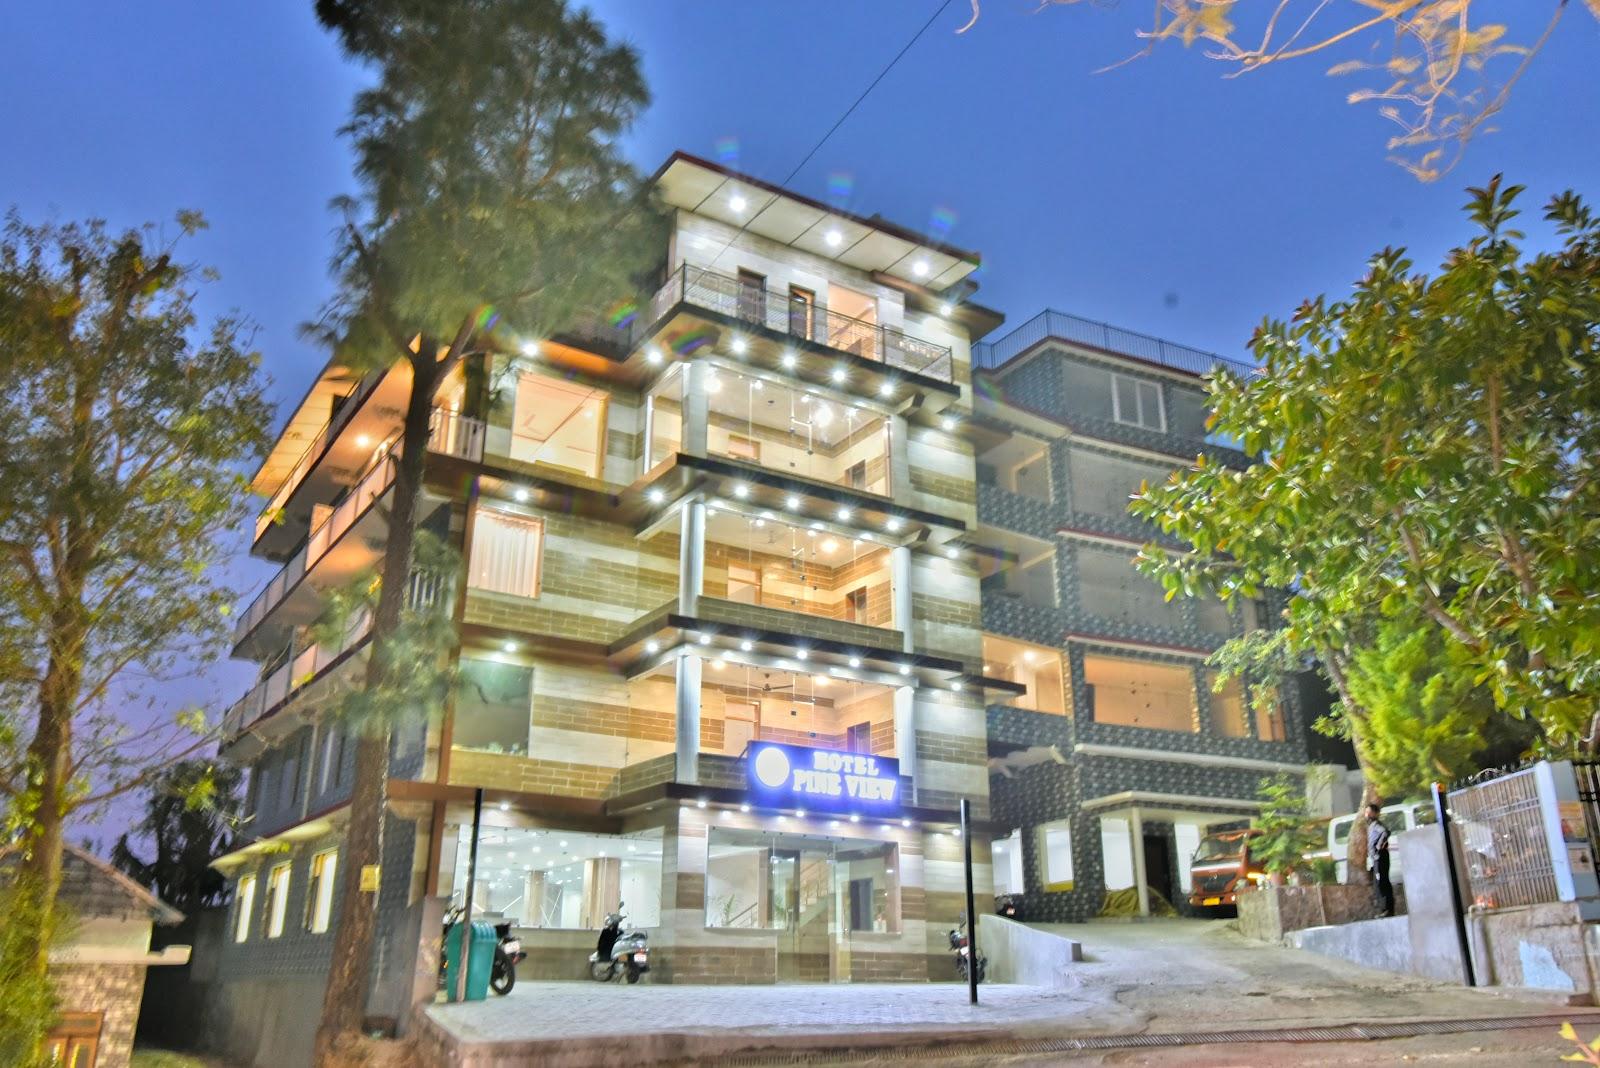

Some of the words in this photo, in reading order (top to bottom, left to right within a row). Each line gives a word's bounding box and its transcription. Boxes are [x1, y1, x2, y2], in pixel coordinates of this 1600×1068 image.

[813, 751, 880, 776] HOTEL
[793, 769, 842, 796] PINE
[844, 775, 897, 801] VIEW
